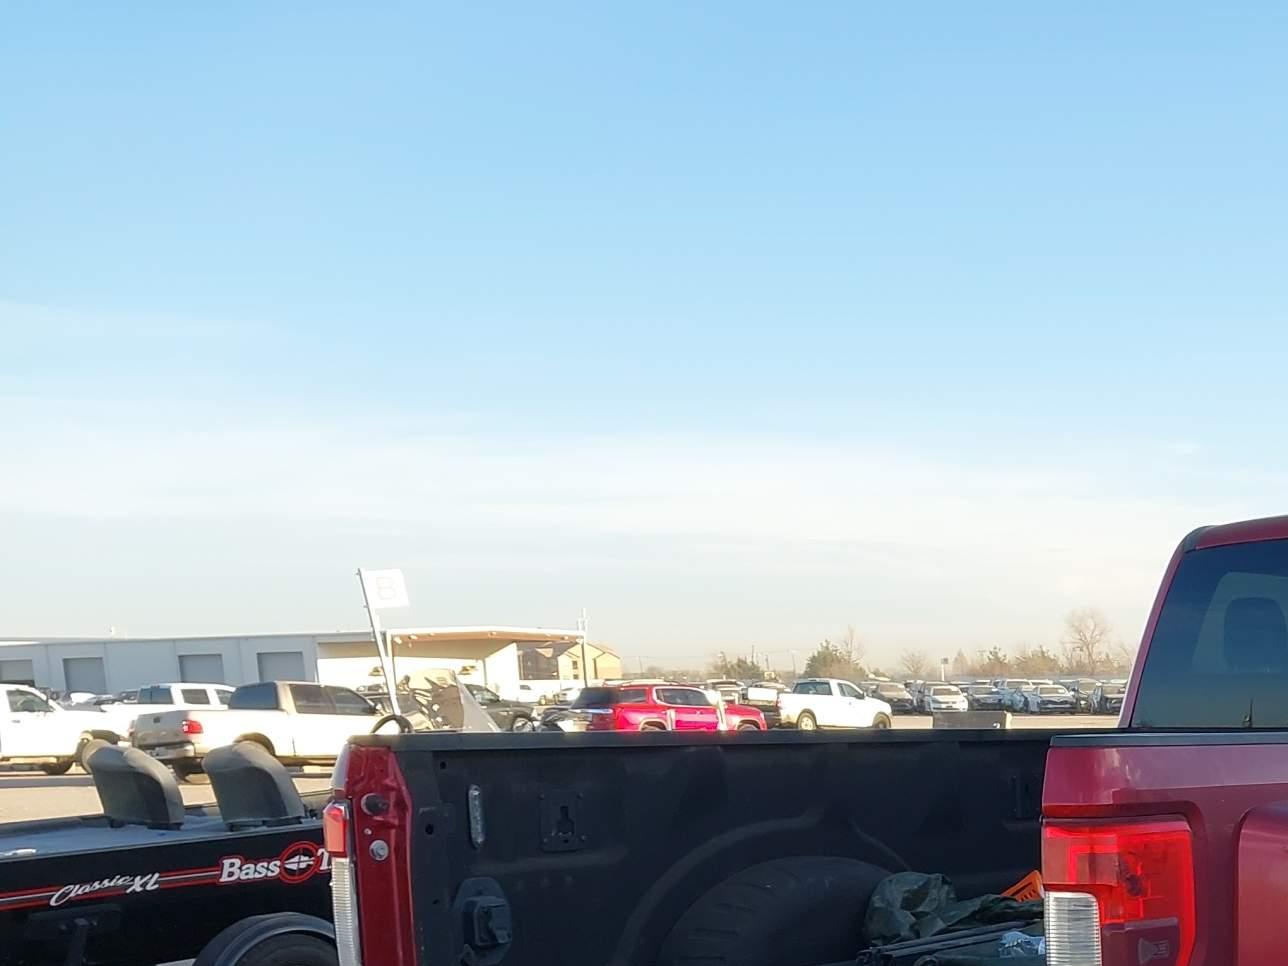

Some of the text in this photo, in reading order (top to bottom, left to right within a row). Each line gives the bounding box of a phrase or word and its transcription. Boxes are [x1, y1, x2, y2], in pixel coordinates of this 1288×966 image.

[219, 858, 281, 883] Bass
[50, 872, 160, 906] Classic XL
